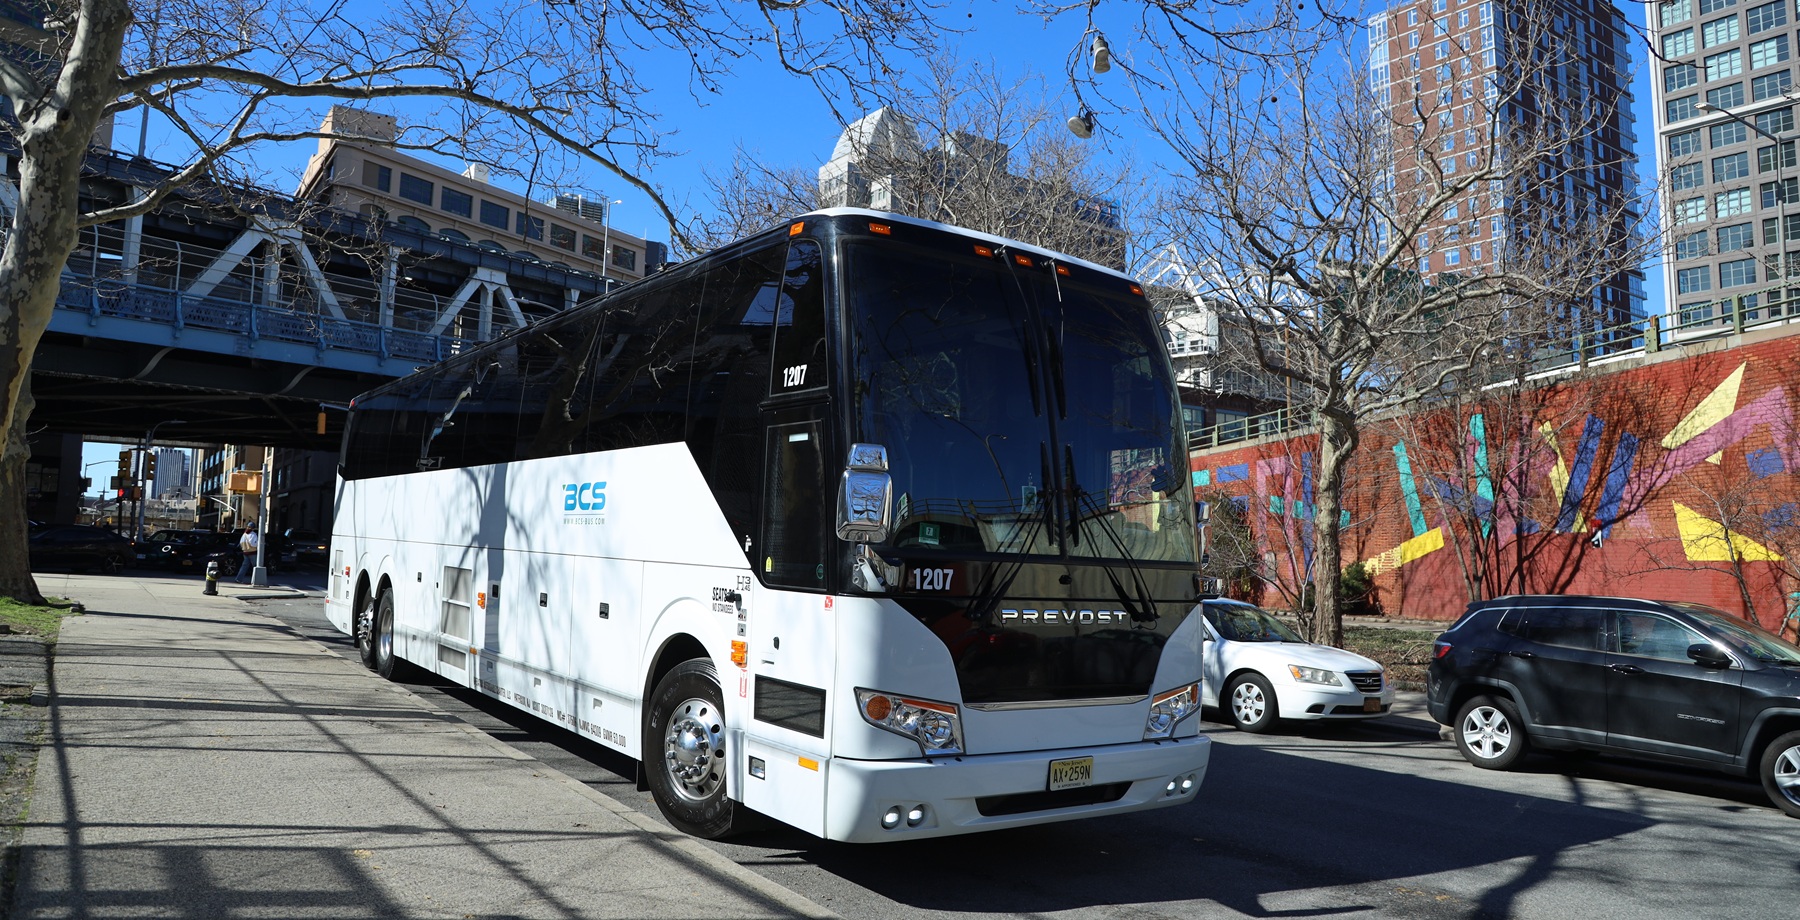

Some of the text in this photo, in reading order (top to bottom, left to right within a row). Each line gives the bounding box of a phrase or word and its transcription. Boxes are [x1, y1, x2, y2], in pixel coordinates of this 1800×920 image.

[783, 364, 808, 388] 1207
[563, 481, 607, 510] BCS
[913, 567, 954, 590] 1207
[1001, 609, 1127, 625] PREVOST
